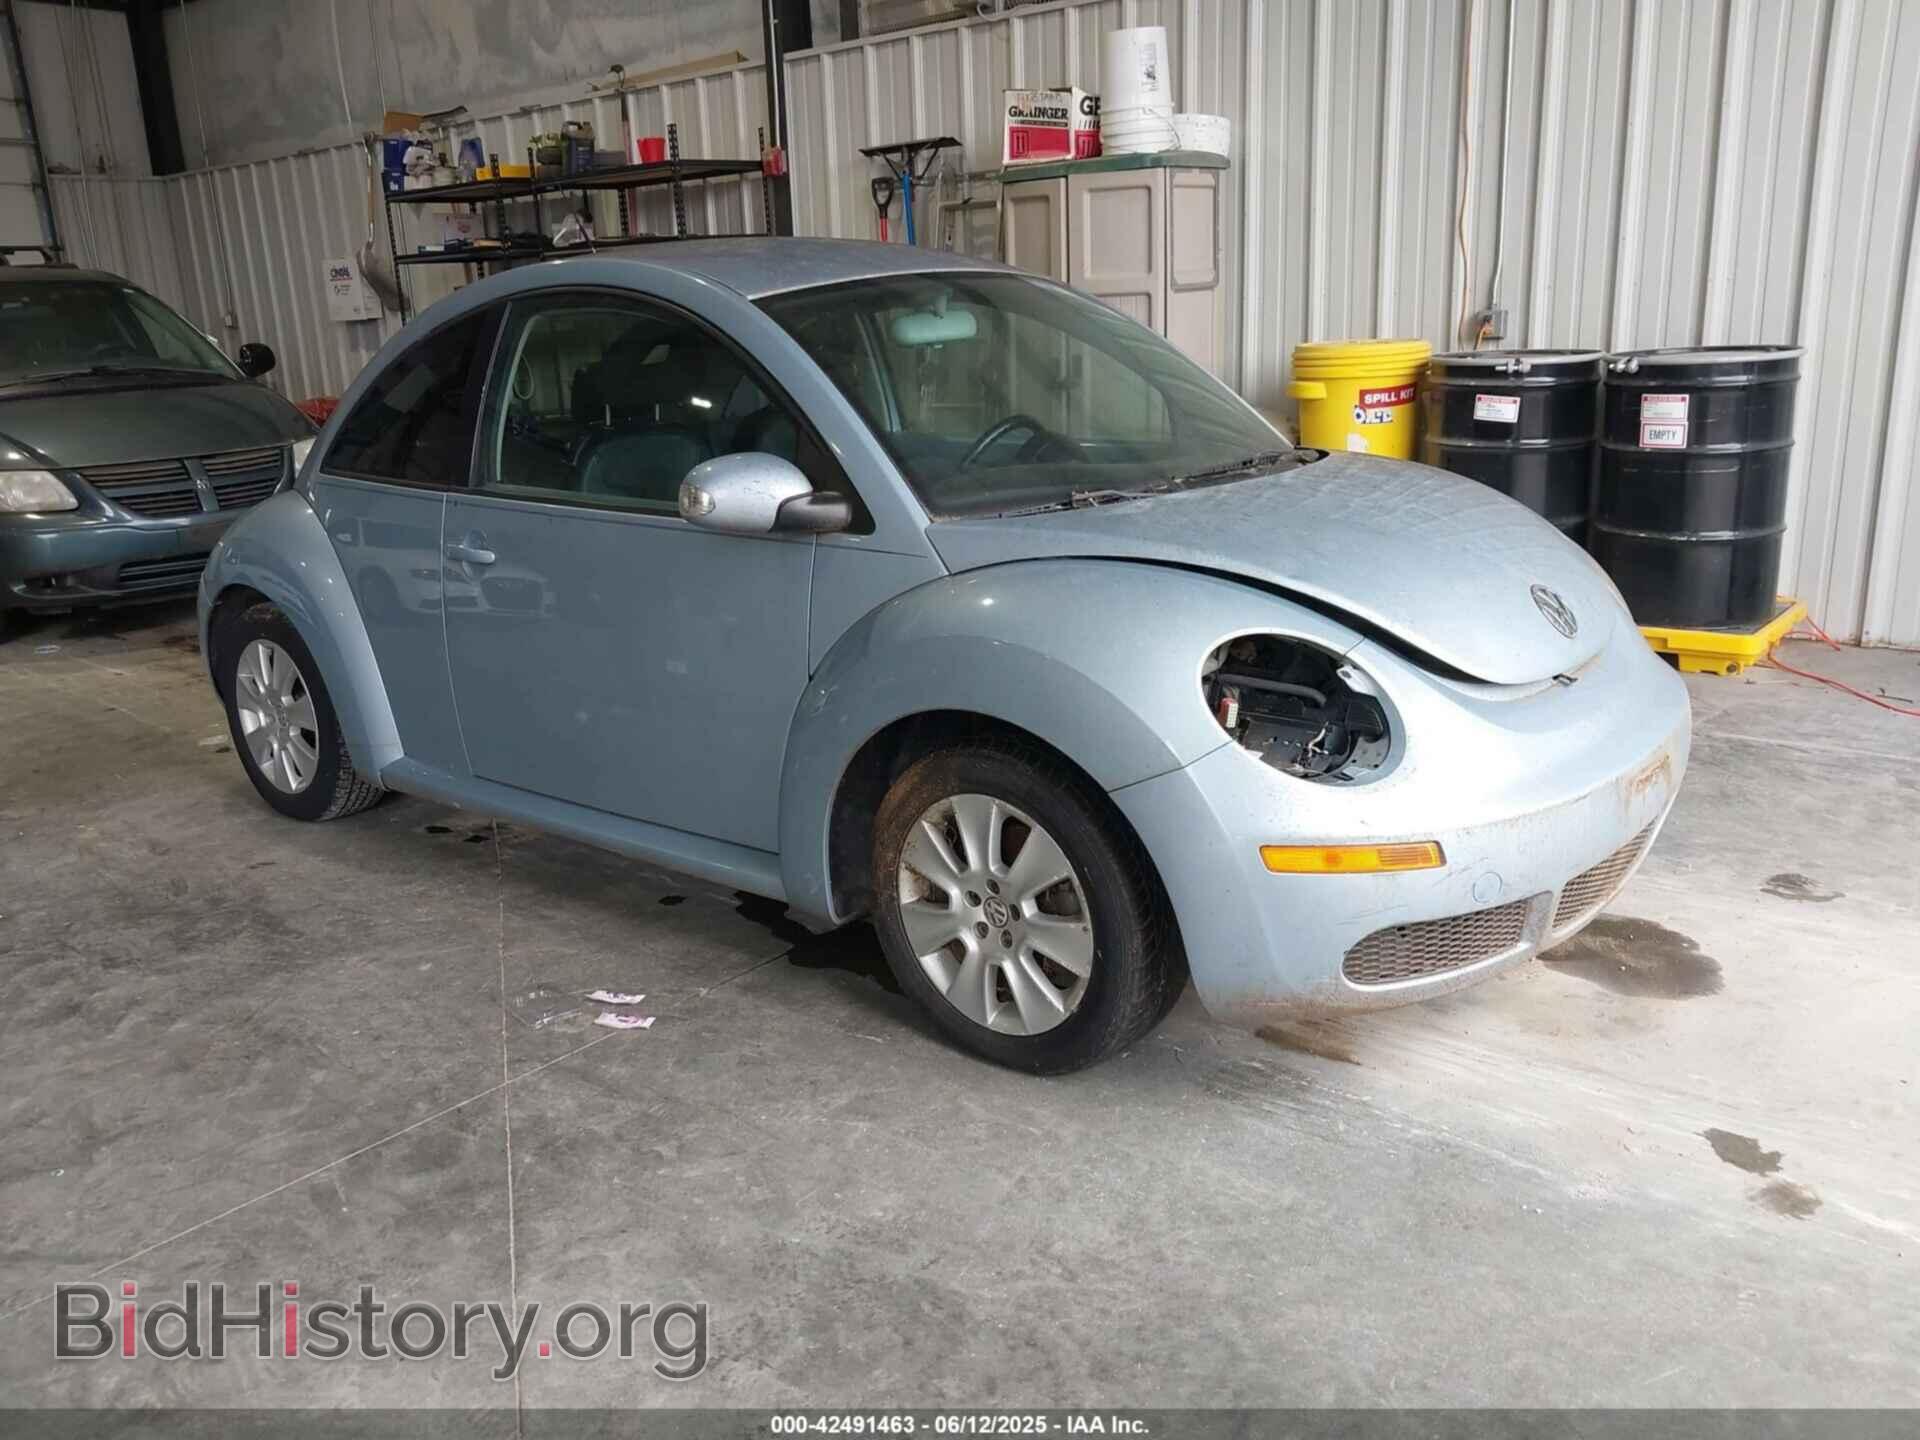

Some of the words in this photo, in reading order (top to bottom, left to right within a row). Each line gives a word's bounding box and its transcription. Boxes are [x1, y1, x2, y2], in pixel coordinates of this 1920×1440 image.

[1008, 106, 1069, 119] GRAINGER
[1363, 392, 1398, 405] SPILL
[1399, 387, 1415, 401] KIT
[1648, 429, 1678, 441] EMPTY
